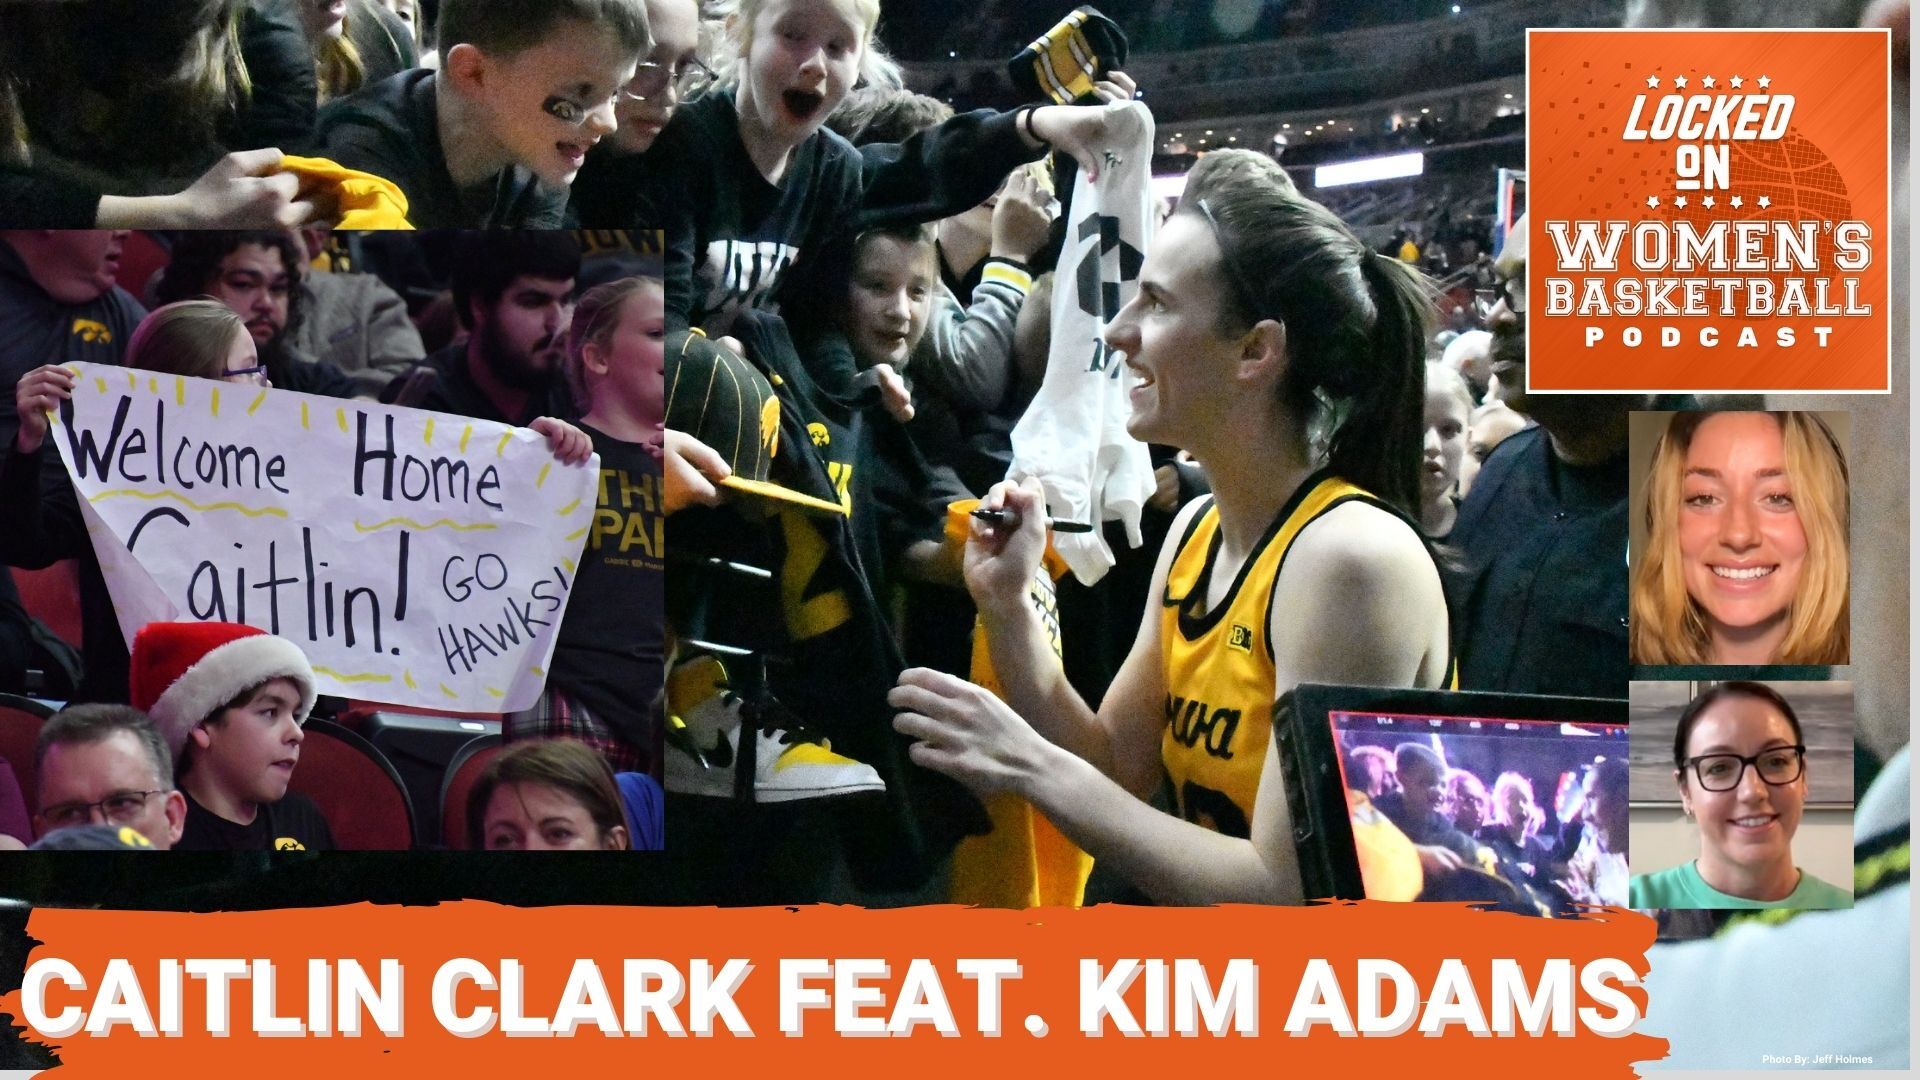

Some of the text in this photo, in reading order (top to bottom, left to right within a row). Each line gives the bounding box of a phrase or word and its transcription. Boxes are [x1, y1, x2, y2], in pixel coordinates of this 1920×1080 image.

[59, 395, 504, 512] Welcome Home
[437, 566, 568, 675] HAWKS!
[442, 552, 509, 603] GO
[1165, 691, 1242, 760] wa
